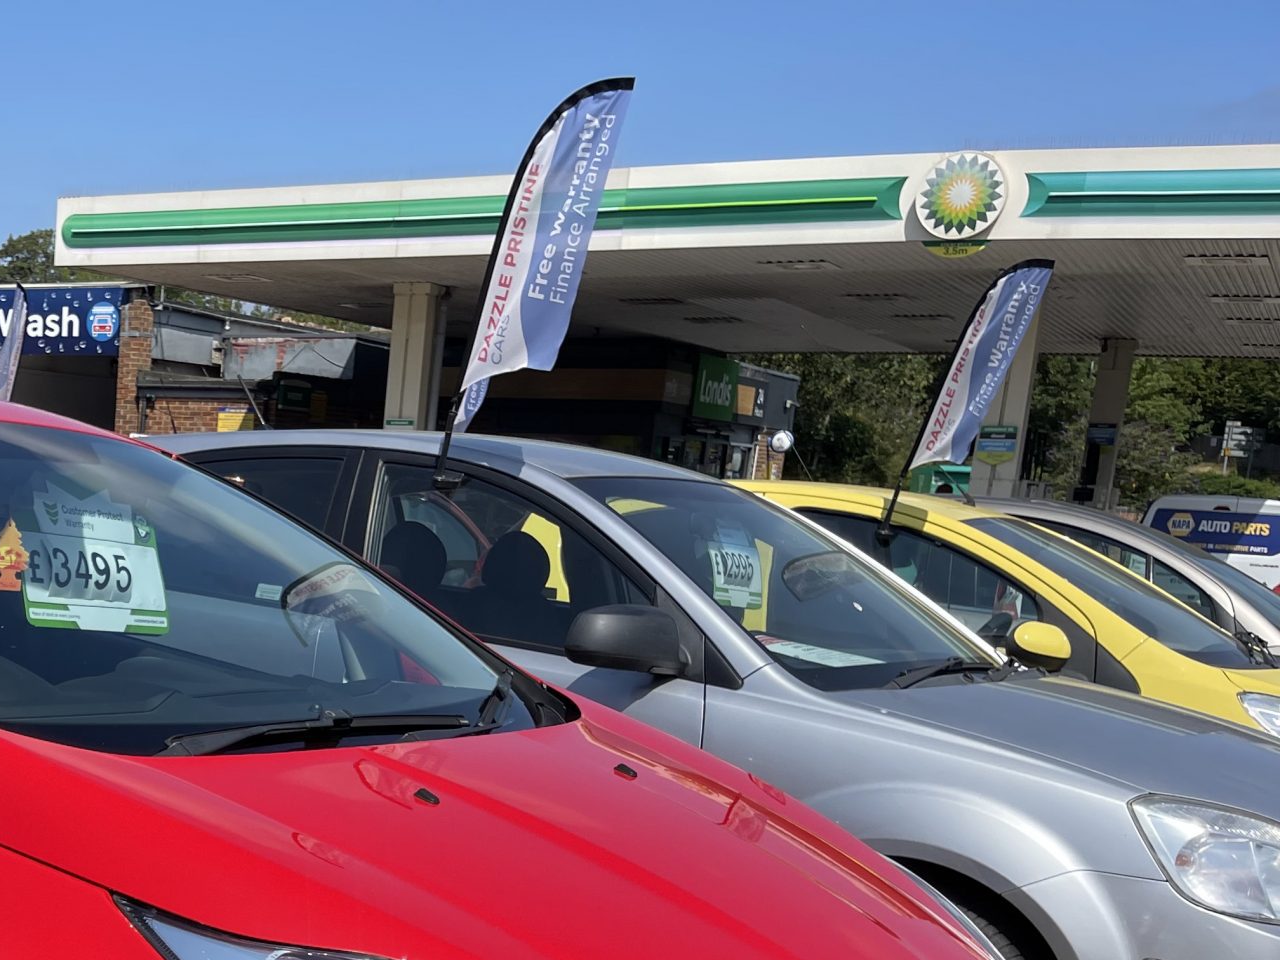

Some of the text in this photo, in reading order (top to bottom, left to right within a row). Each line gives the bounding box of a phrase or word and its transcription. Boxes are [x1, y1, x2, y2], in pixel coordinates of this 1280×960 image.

[549, 113, 617, 305] Finance Arranged
[477, 162, 544, 363] DAZZLE PRISTINE
[527, 241, 557, 301] Free
[491, 314, 511, 366] CARS
[968, 281, 1029, 412] Free Warranty
[1006, 284, 1041, 356] Arranged
[699, 368, 733, 407] Londis
[925, 307, 987, 452] DAZZLE PRISTINE
[1171, 519, 1271, 536] NAPA AUTO PARTS
[28, 547, 133, 593] £3495
